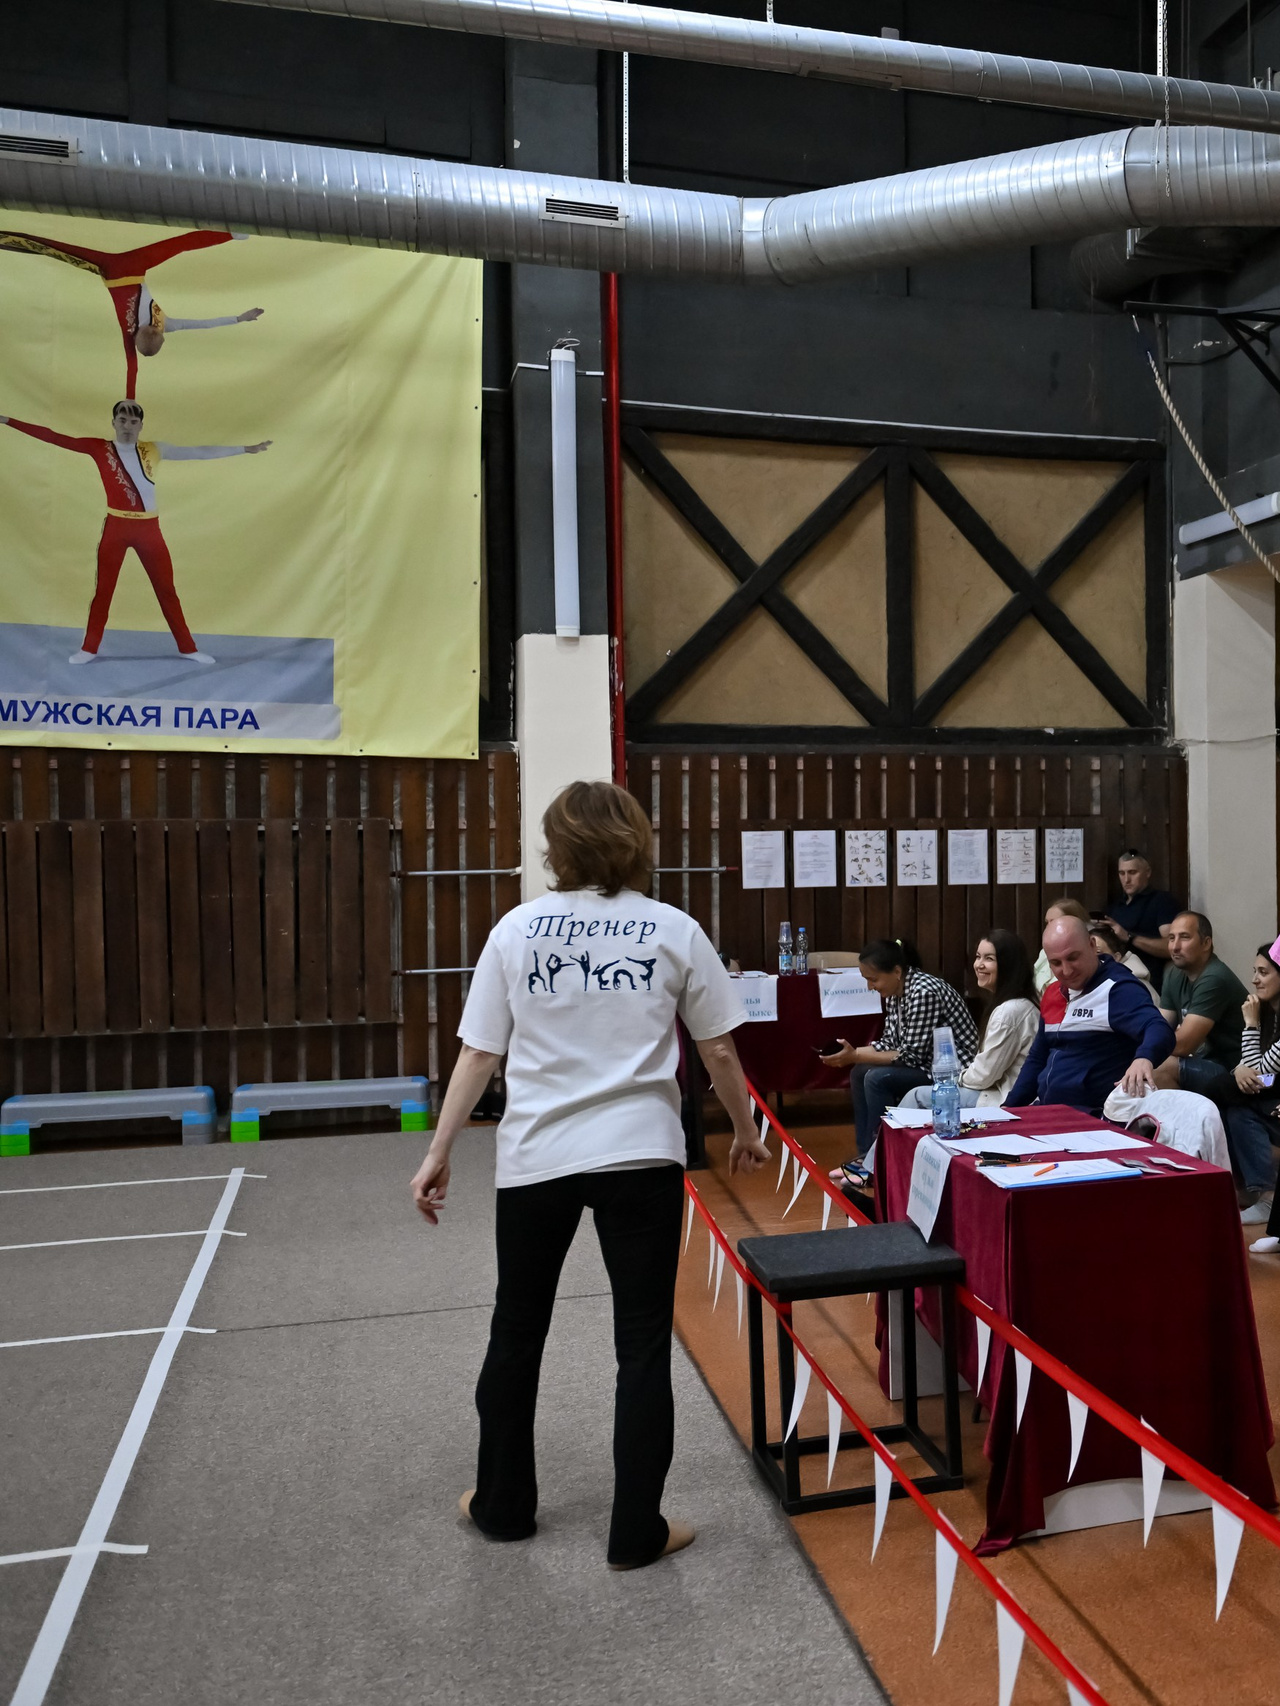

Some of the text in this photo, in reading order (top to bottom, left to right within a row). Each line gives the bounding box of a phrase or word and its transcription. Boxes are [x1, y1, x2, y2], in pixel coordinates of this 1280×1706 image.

[0, 700, 260, 730] МУЖСКАЯ ПАРА
[526, 912, 656, 946] Тренер
[824, 987, 876, 996] Комментатр
